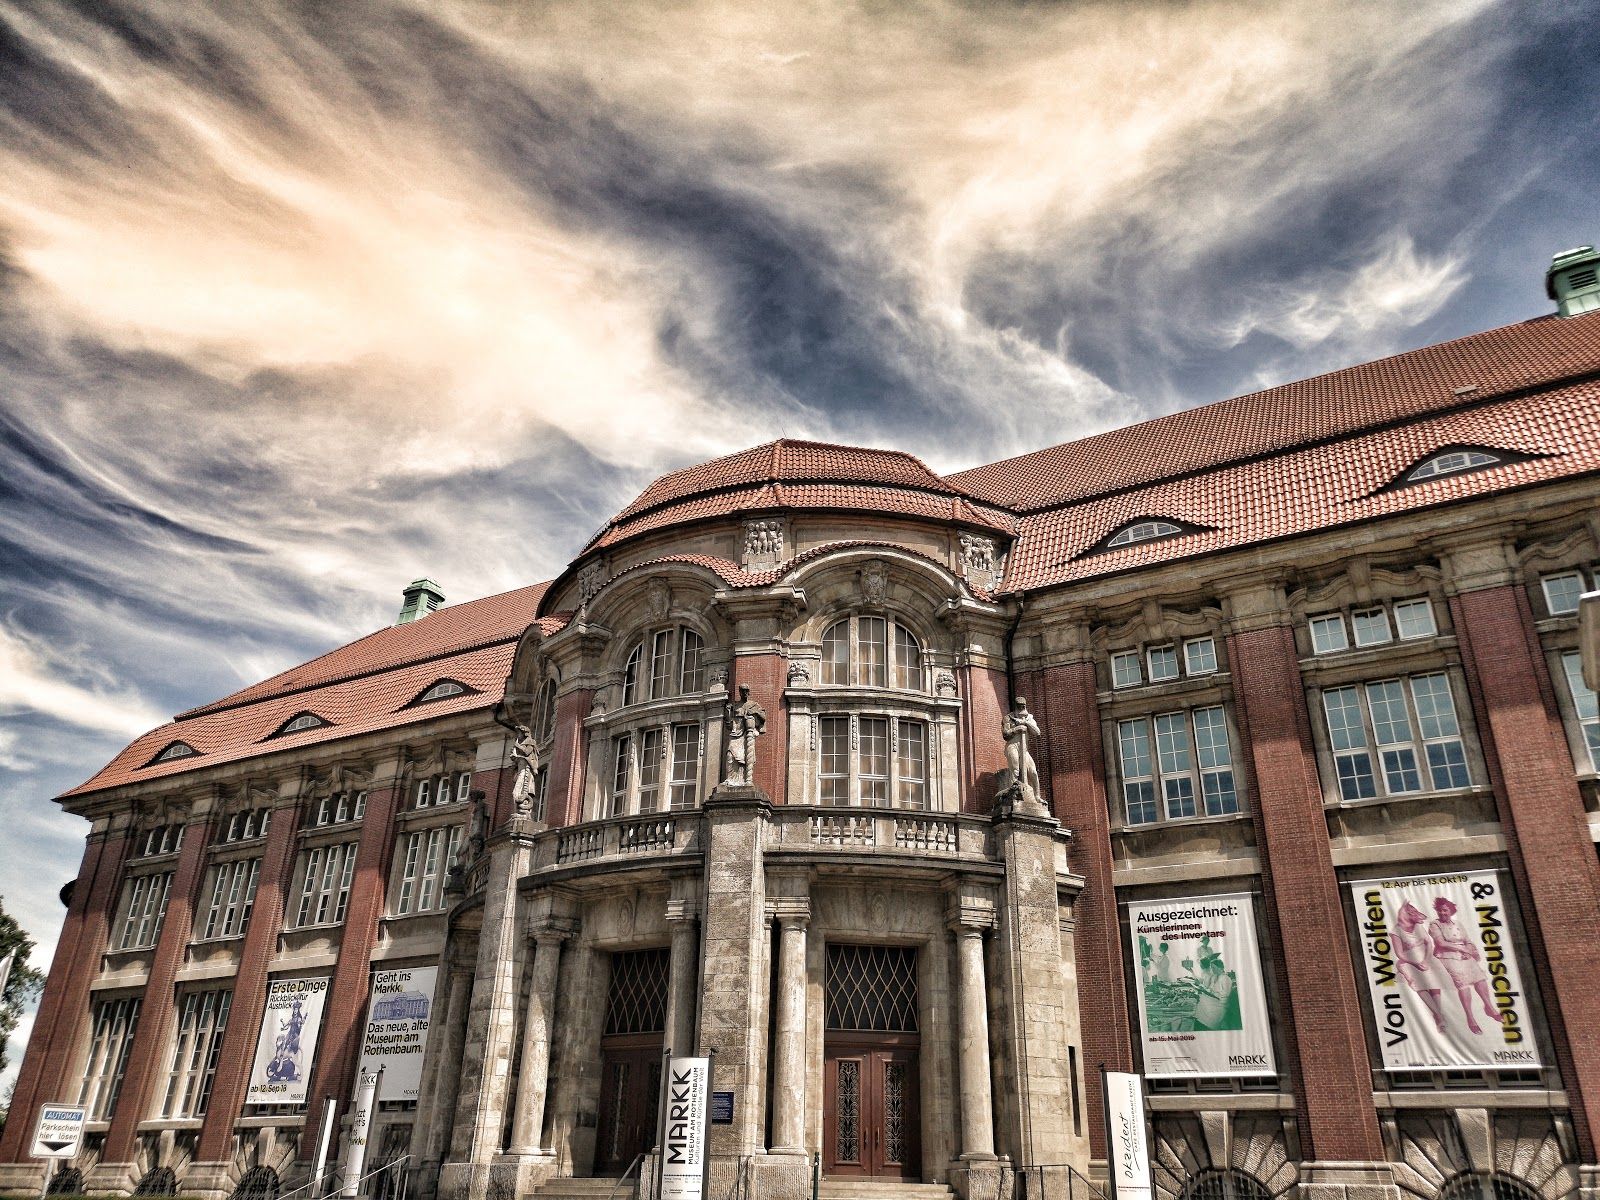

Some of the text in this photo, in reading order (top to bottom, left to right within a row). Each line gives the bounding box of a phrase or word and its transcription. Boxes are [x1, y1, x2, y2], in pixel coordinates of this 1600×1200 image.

[1394, 880, 1410, 889] Apr
[1412, 878, 1425, 887] bis
[1440, 876, 1456, 885] Okt
[1457, 875, 1468, 883] 19
[1470, 882, 1495, 901] &
[1137, 905, 1238, 923] Ausgezeichnet:
[1137, 922, 1202, 934] Künstlerinnen
[1161, 932, 1180, 941] des
[1364, 891, 1396, 986] Wölfen
[376, 971, 412, 983] Geht ins
[1475, 905, 1524, 1044] Menschen
[271, 980, 327, 994] Erste Dinge
[374, 982, 403, 995] Markk.
[368, 1020, 429, 1034] Das neue, alte
[1384, 993, 1409, 1048] Von
[365, 1033, 419, 1045] Museum am
[363, 1043, 423, 1056] Rothenbaum.
[1494, 1050, 1533, 1060] MARKK
[1228, 1055, 1268, 1066] MARKK
[250, 1084, 259, 1093] ab
[269, 1084, 280, 1094] Sep
[691, 1067, 699, 1118] ROTHENBAUM
[46, 1111, 81, 1120] AUTOMAT
[667, 1068, 692, 1165] MARKK
[41, 1122, 80, 1132] Parkschein
[691, 1119, 696, 1131] AM
[58, 1132, 78, 1141] lösen
[694, 1136, 702, 1165] Kulturen
